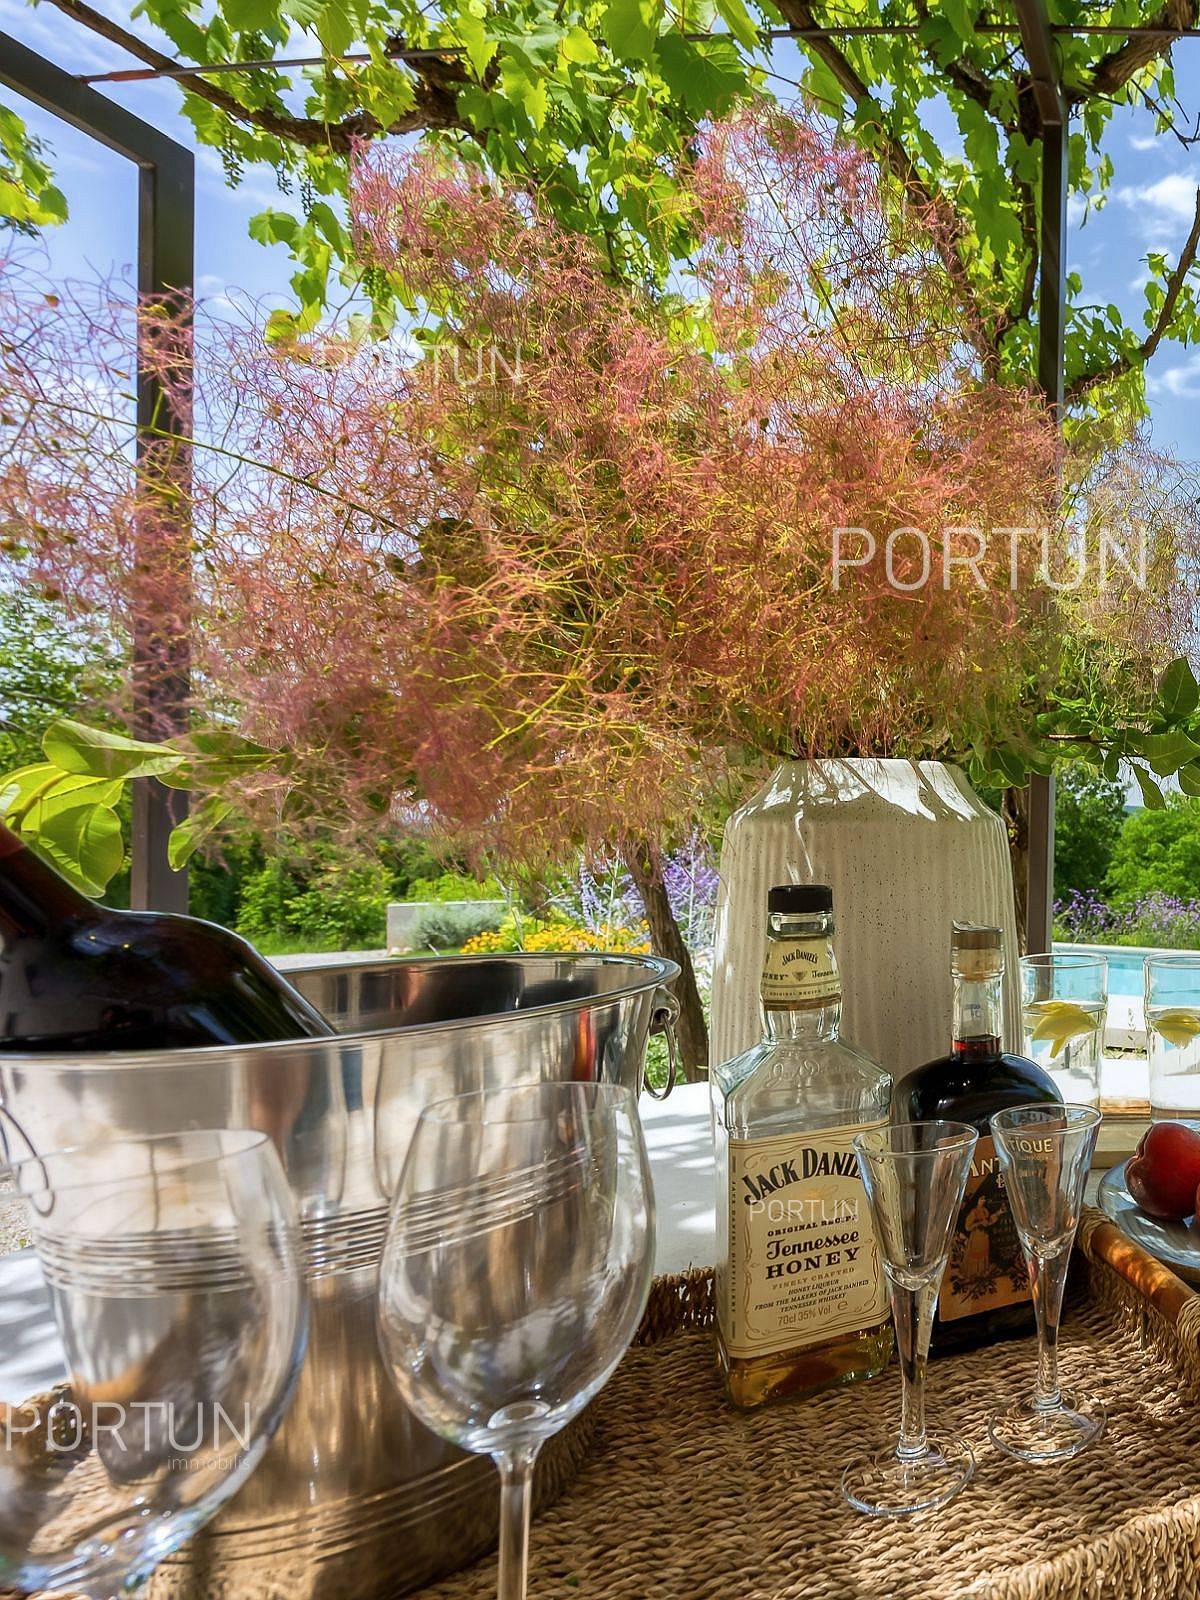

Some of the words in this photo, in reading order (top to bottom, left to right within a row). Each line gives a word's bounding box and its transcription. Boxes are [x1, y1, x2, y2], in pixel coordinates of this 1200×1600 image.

[782, 951, 796, 966] JACK
[742, 1159, 801, 1206] JACK
[767, 1222, 818, 1237] ORIGINAL
[766, 1230, 860, 1260] Tennessee
[765, 1246, 861, 1280] HONEY
[772, 1277, 808, 1290] FINELY
[811, 1267, 855, 1281] CRAFTED
[788, 1284, 811, 1295] HONEY
[812, 1278, 840, 1291] LIQUEUR
[754, 1302, 774, 1311] FROM
[775, 1298, 790, 1306] THE
[790, 1292, 818, 1303] MAKERS
[818, 1288, 827, 1296] OF
[826, 1285, 843, 1295] JACK
[780, 1299, 817, 1313] TENNESSEE
[818, 1292, 847, 1304] WHISKEY
[777, 1313, 797, 1326] 70cl
[798, 1308, 817, 1321] 35%
